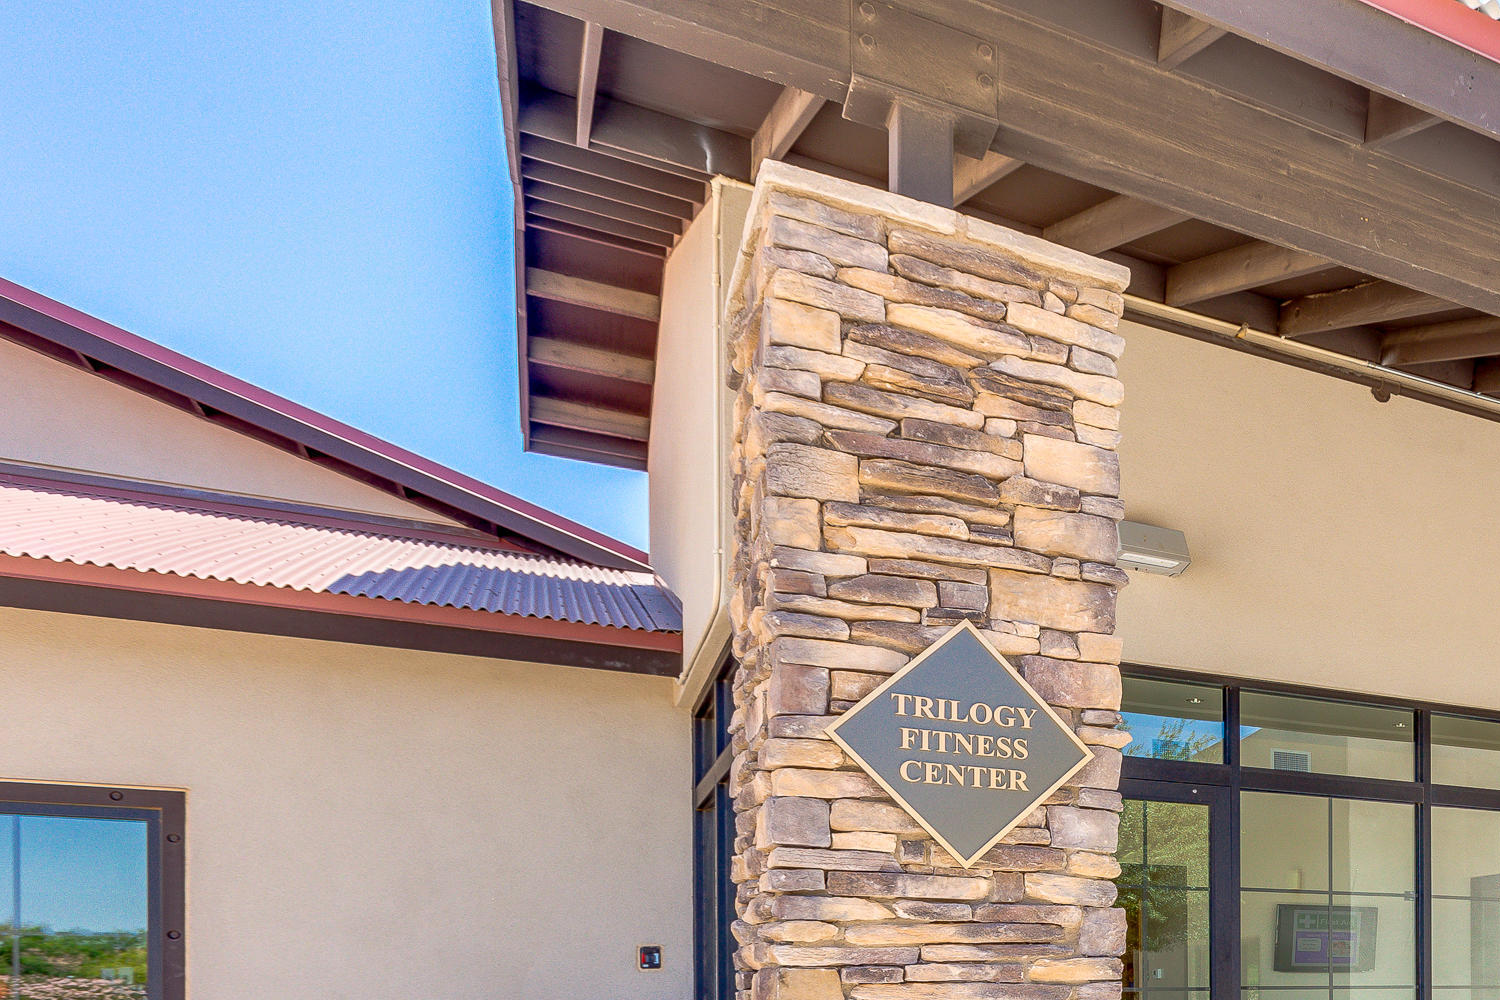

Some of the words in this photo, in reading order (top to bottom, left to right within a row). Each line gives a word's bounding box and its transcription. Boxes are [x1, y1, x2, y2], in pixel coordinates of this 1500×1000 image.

[890, 692, 1038, 730] TRILOGY
[898, 727, 1029, 760] FITNESS
[899, 760, 1030, 792] CENTER
